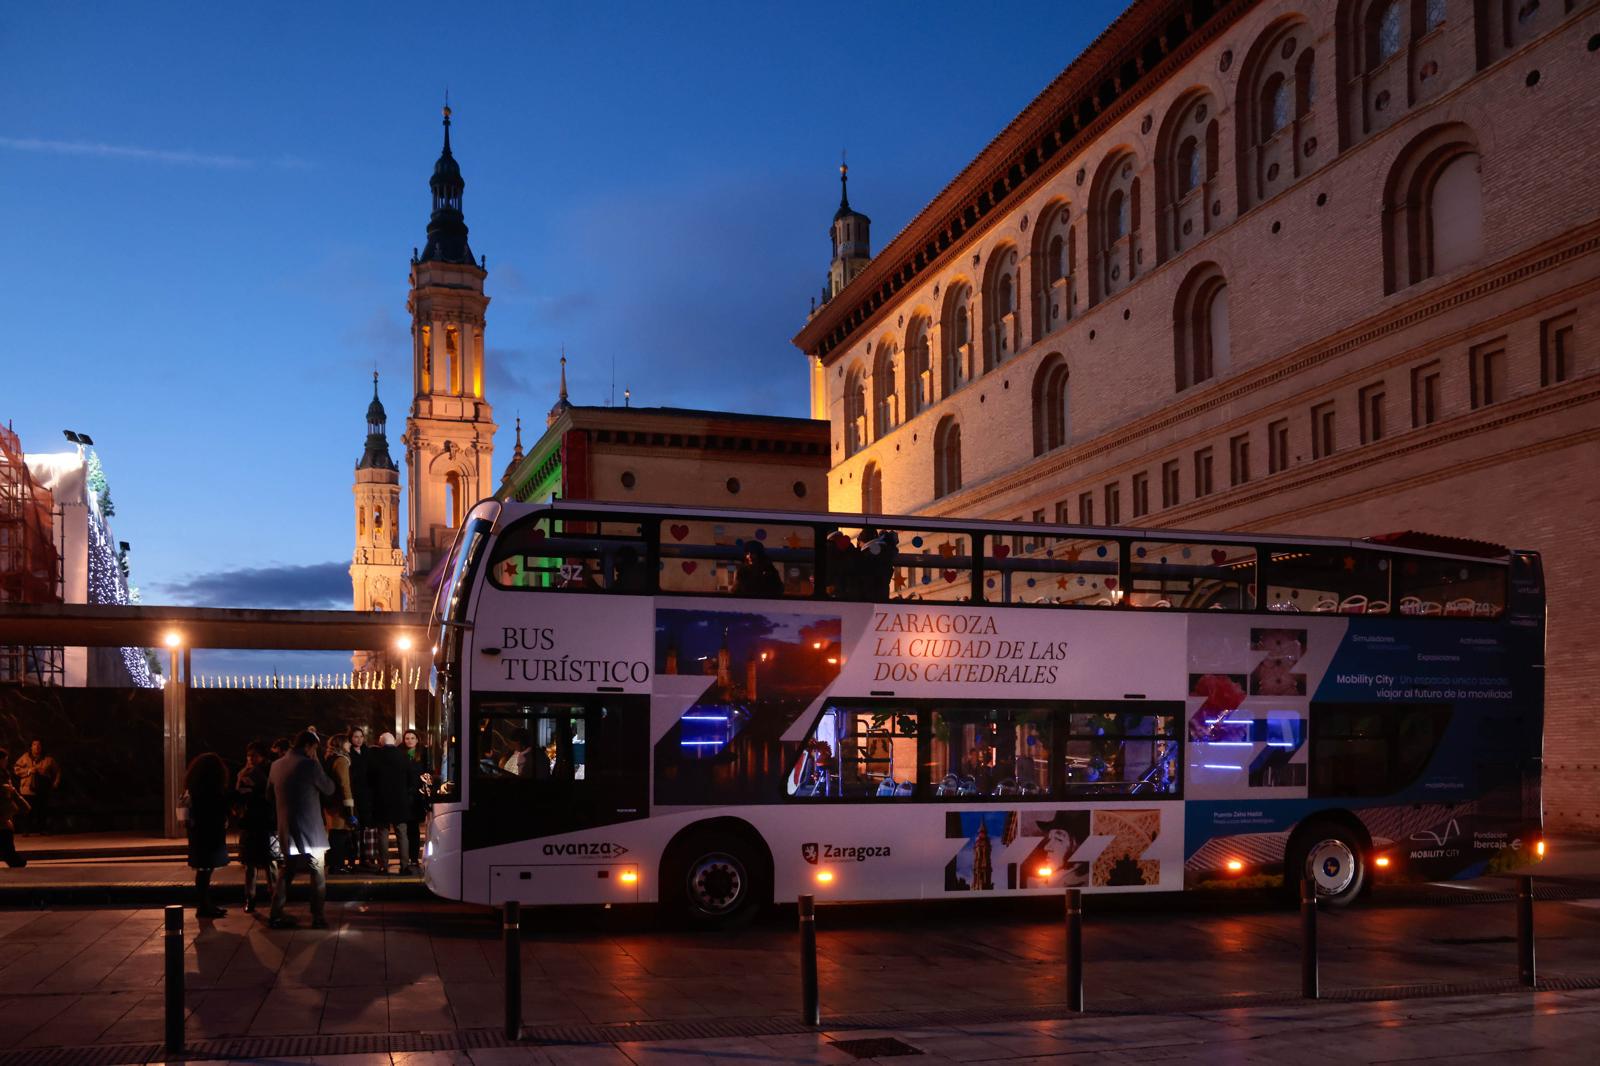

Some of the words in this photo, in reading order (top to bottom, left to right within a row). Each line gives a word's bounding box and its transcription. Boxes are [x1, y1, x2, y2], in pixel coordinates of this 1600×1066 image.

[875, 612, 998, 634] ZARAGOZA
[501, 627, 554, 650] BUS
[873, 638, 902, 656] LA
[908, 638, 991, 659] CIUDAD
[996, 640, 1025, 660] DE
[1028, 641, 1068, 660] LAS
[501, 655, 650, 683] TURÍSTICO
[873, 662, 918, 682] DOS
[924, 663, 1058, 684] CATEDRALES
[1336, 674, 1373, 686] Mobility
[1375, 674, 1394, 686] City
[1376, 688, 1404, 700] viajar
[1404, 688, 1413, 698] al
[1414, 688, 1442, 698] futuro
[1444, 688, 1456, 698] de
[1458, 688, 1467, 698] la
[1468, 688, 1512, 699] movilidad
[543, 842, 610, 856] avanza
[824, 845, 890, 862] Zaragoza
[1410, 850, 1446, 858] MOBILITY
[1446, 848, 1460, 857] CITY
[1474, 840, 1508, 850] Ibercaja
